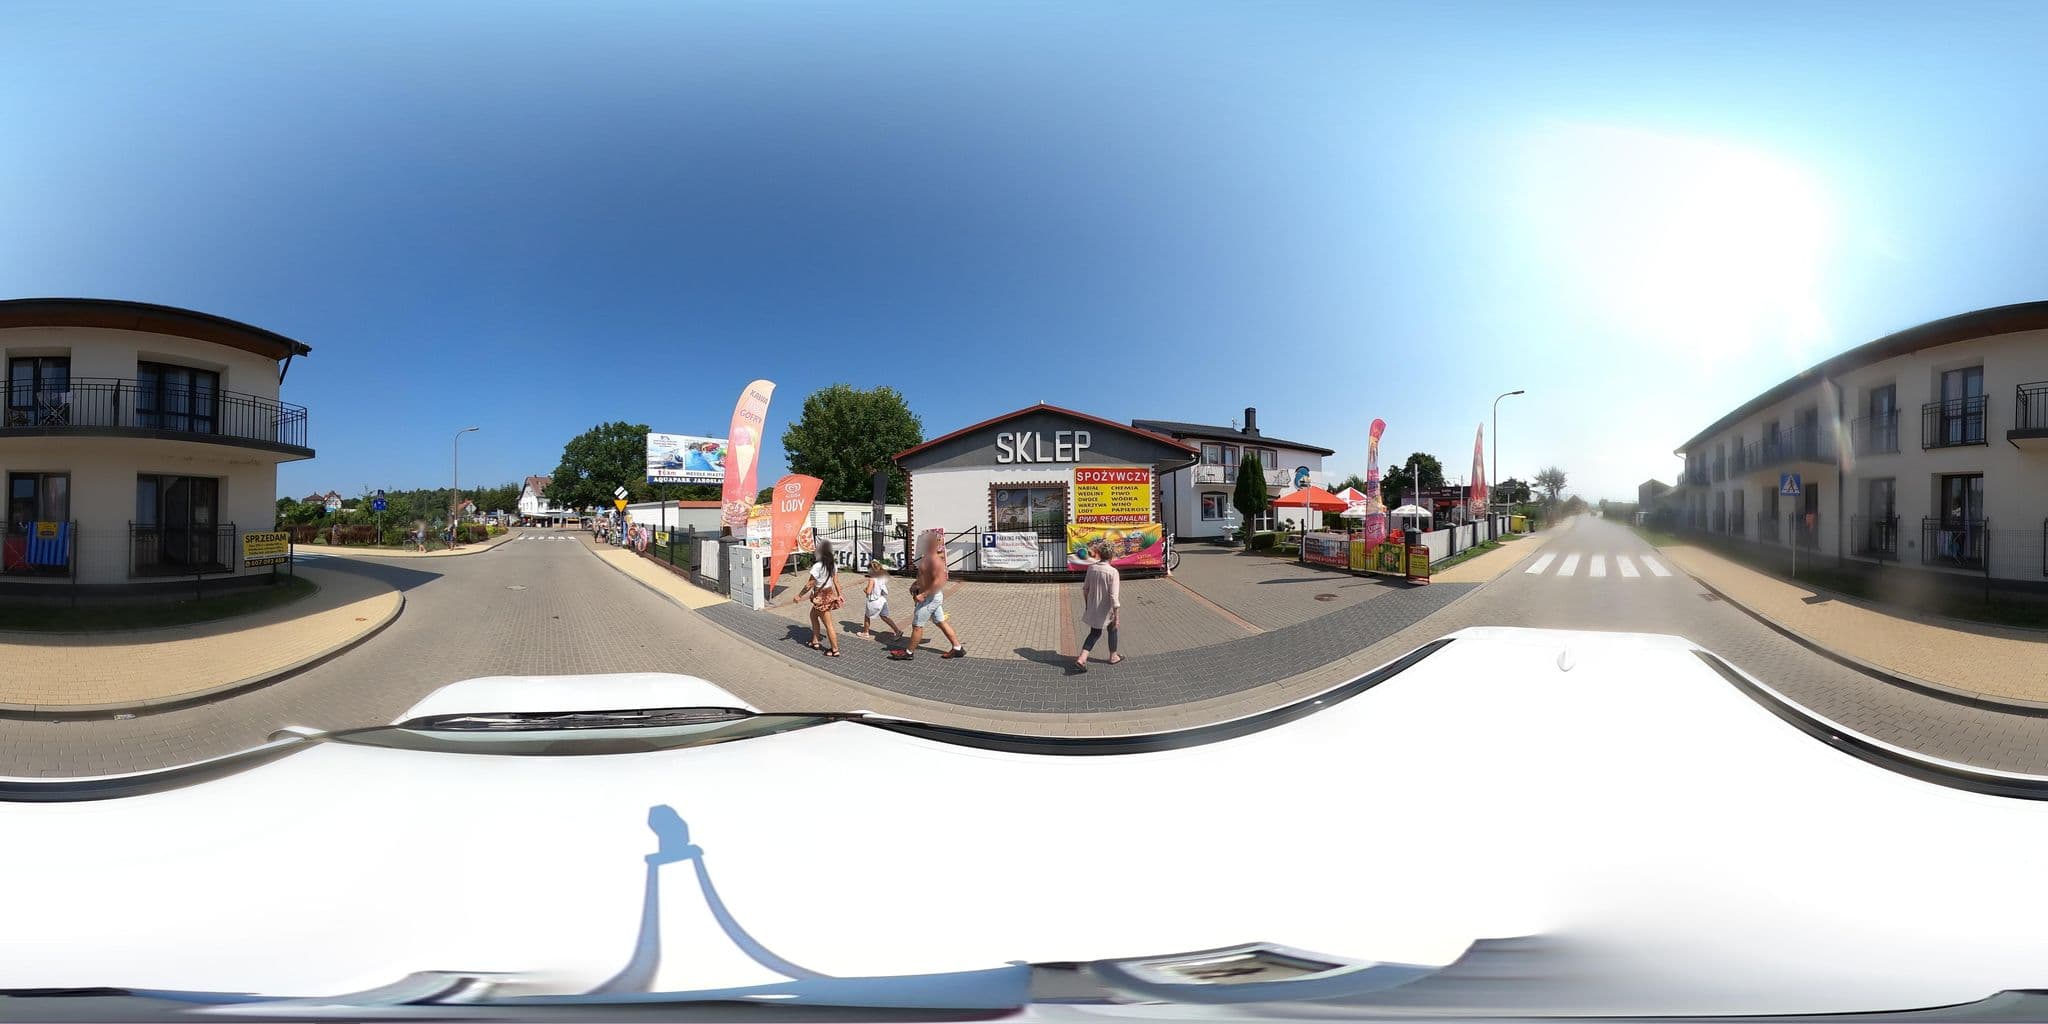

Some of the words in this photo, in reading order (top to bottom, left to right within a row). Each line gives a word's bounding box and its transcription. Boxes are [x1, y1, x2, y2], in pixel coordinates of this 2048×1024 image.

[740, 409, 762, 424] GOFRY
[997, 430, 1091, 463] SKLEP
[1077, 470, 1148, 481] SPOŻYWCZY
[782, 499, 804, 512] LODY
[245, 534, 287, 543] SPRZEDAM
